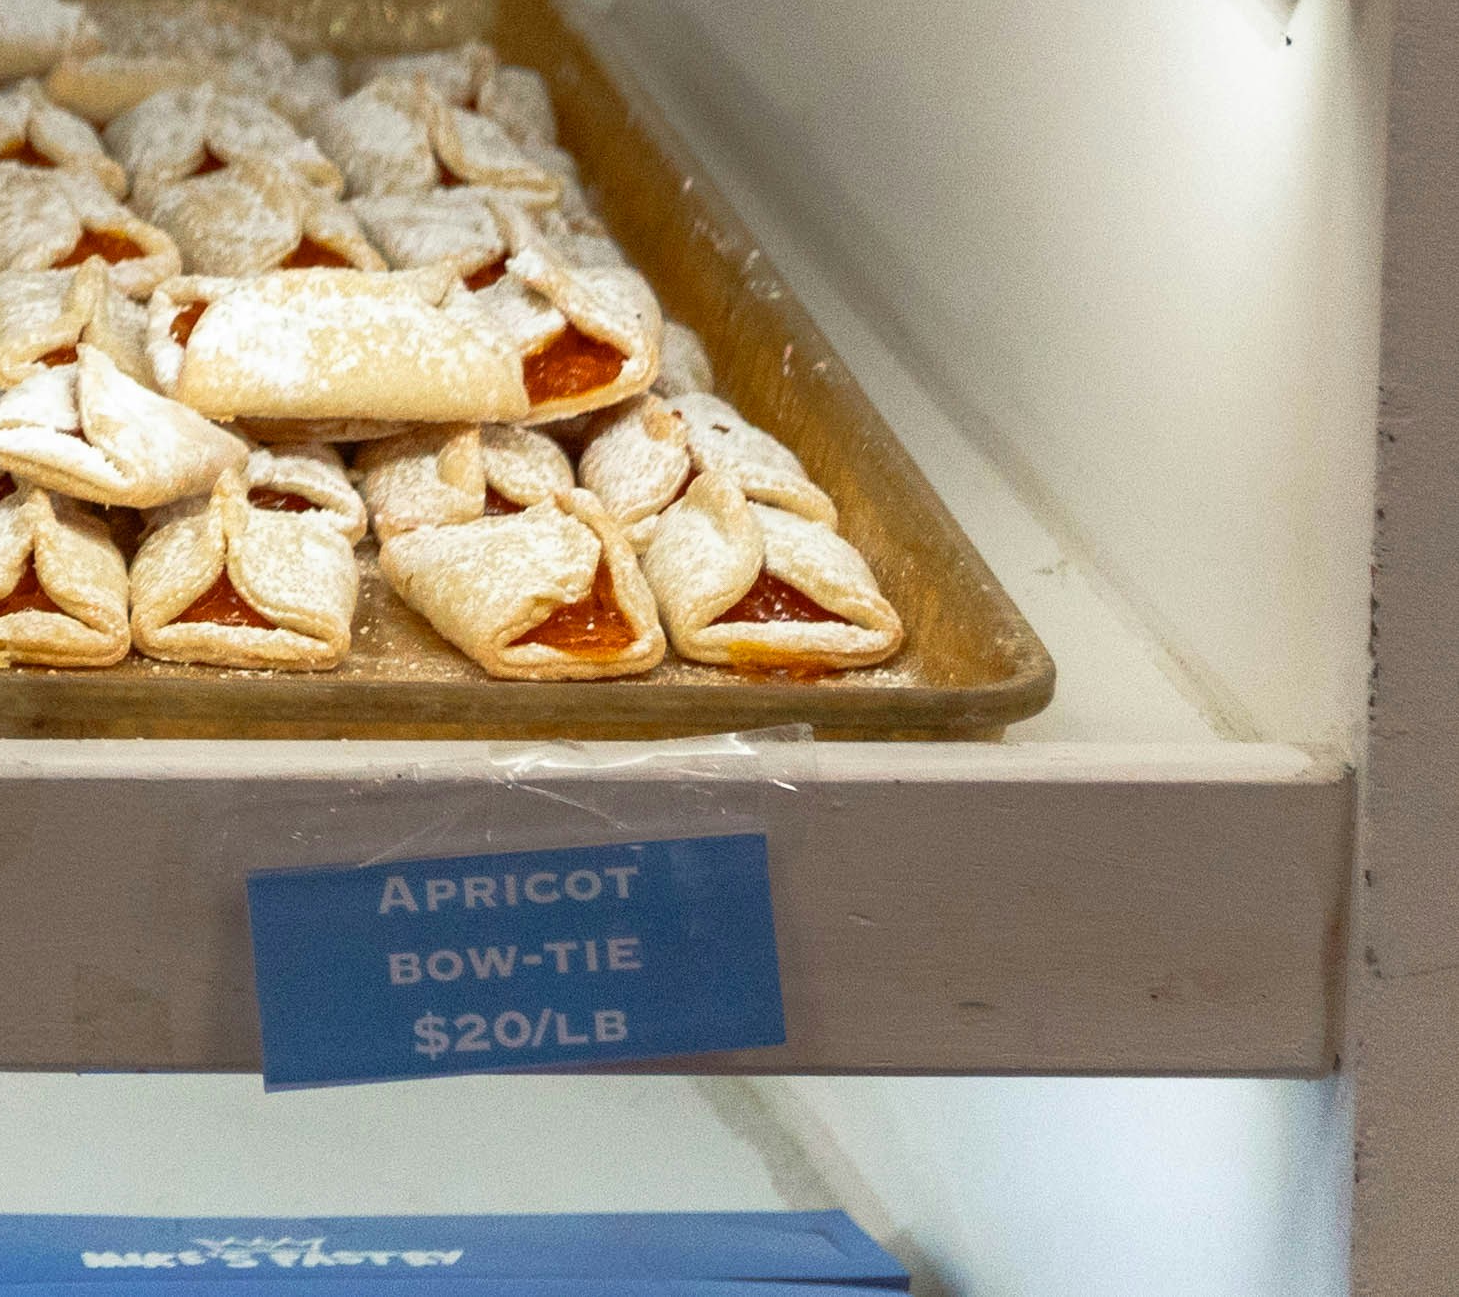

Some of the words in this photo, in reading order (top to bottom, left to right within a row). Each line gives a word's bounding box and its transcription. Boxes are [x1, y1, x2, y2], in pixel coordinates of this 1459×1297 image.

[379, 866, 638, 915] APRICOT
[387, 936, 642, 986] BOW-TIE
[413, 1008, 628, 1059] $20/LB
